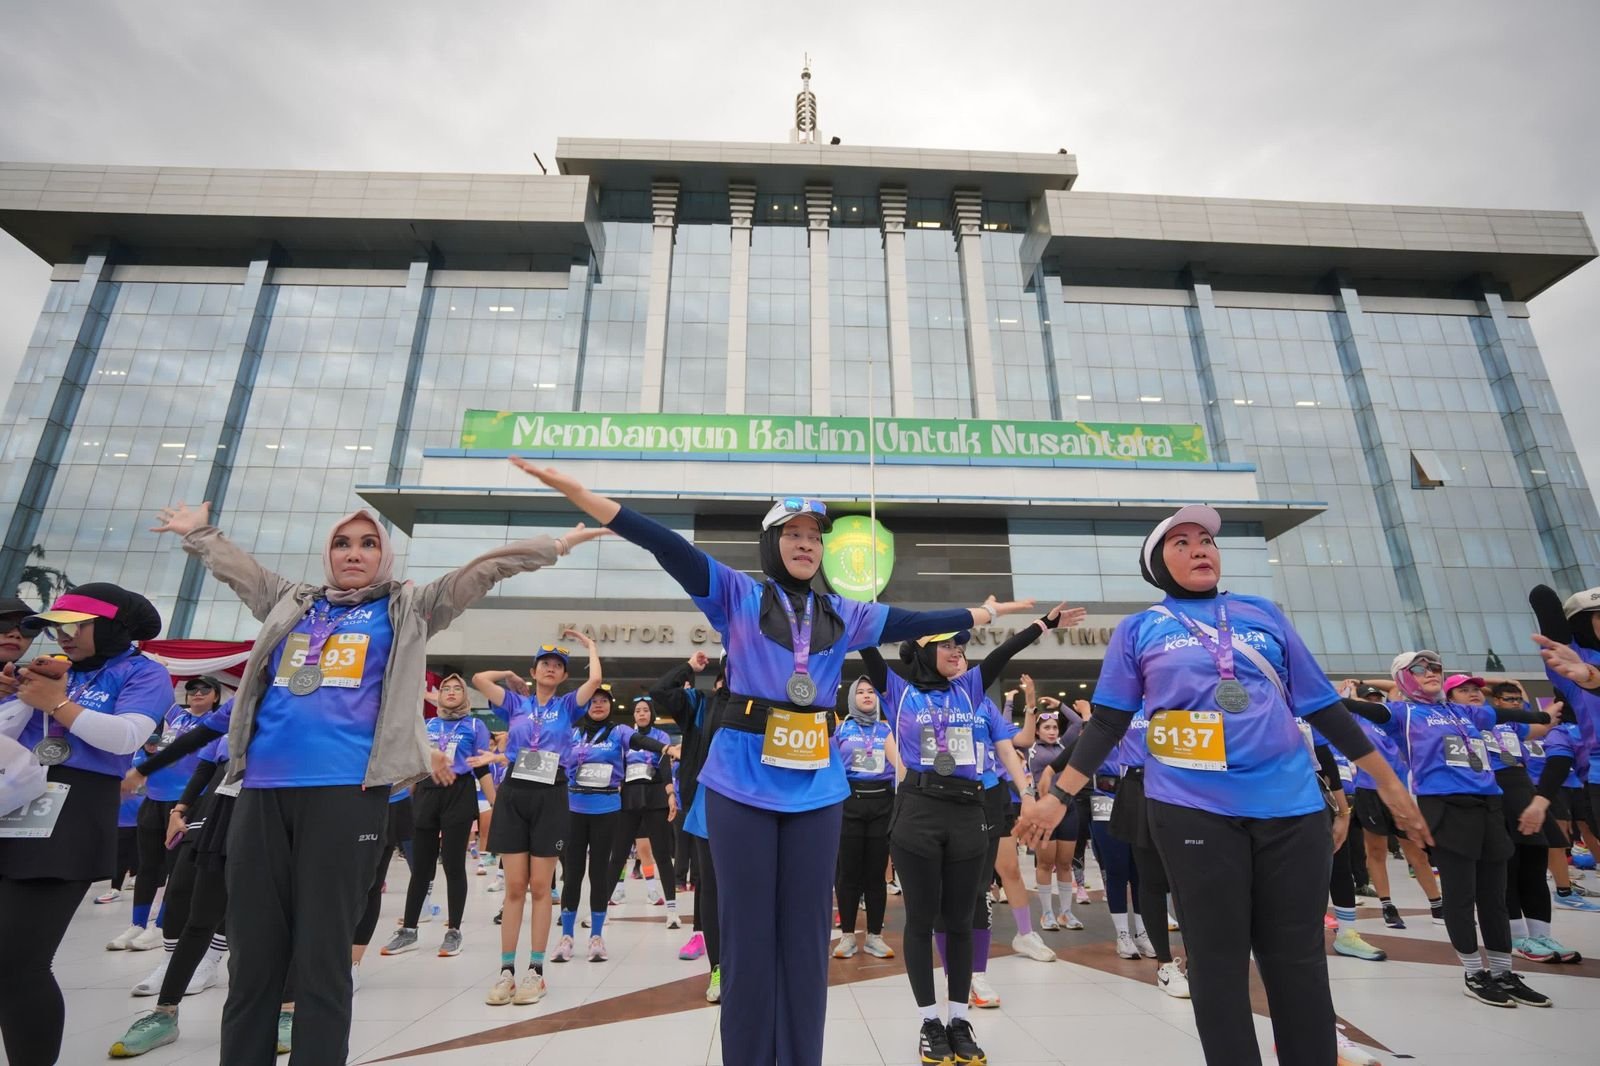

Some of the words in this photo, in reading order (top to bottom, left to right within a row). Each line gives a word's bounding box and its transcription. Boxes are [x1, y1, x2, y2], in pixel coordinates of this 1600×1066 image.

[511, 415, 737, 452] Membangun
[749, 419, 865, 452] Kaltim
[875, 422, 982, 454] Untuk
[991, 424, 1174, 458] Nusantara
[557, 623, 675, 644] KANTOR
[290, 648, 356, 668] 593
[772, 726, 825, 750] 5001
[926, 737, 968, 752] 308
[1153, 726, 1214, 749] 5137
